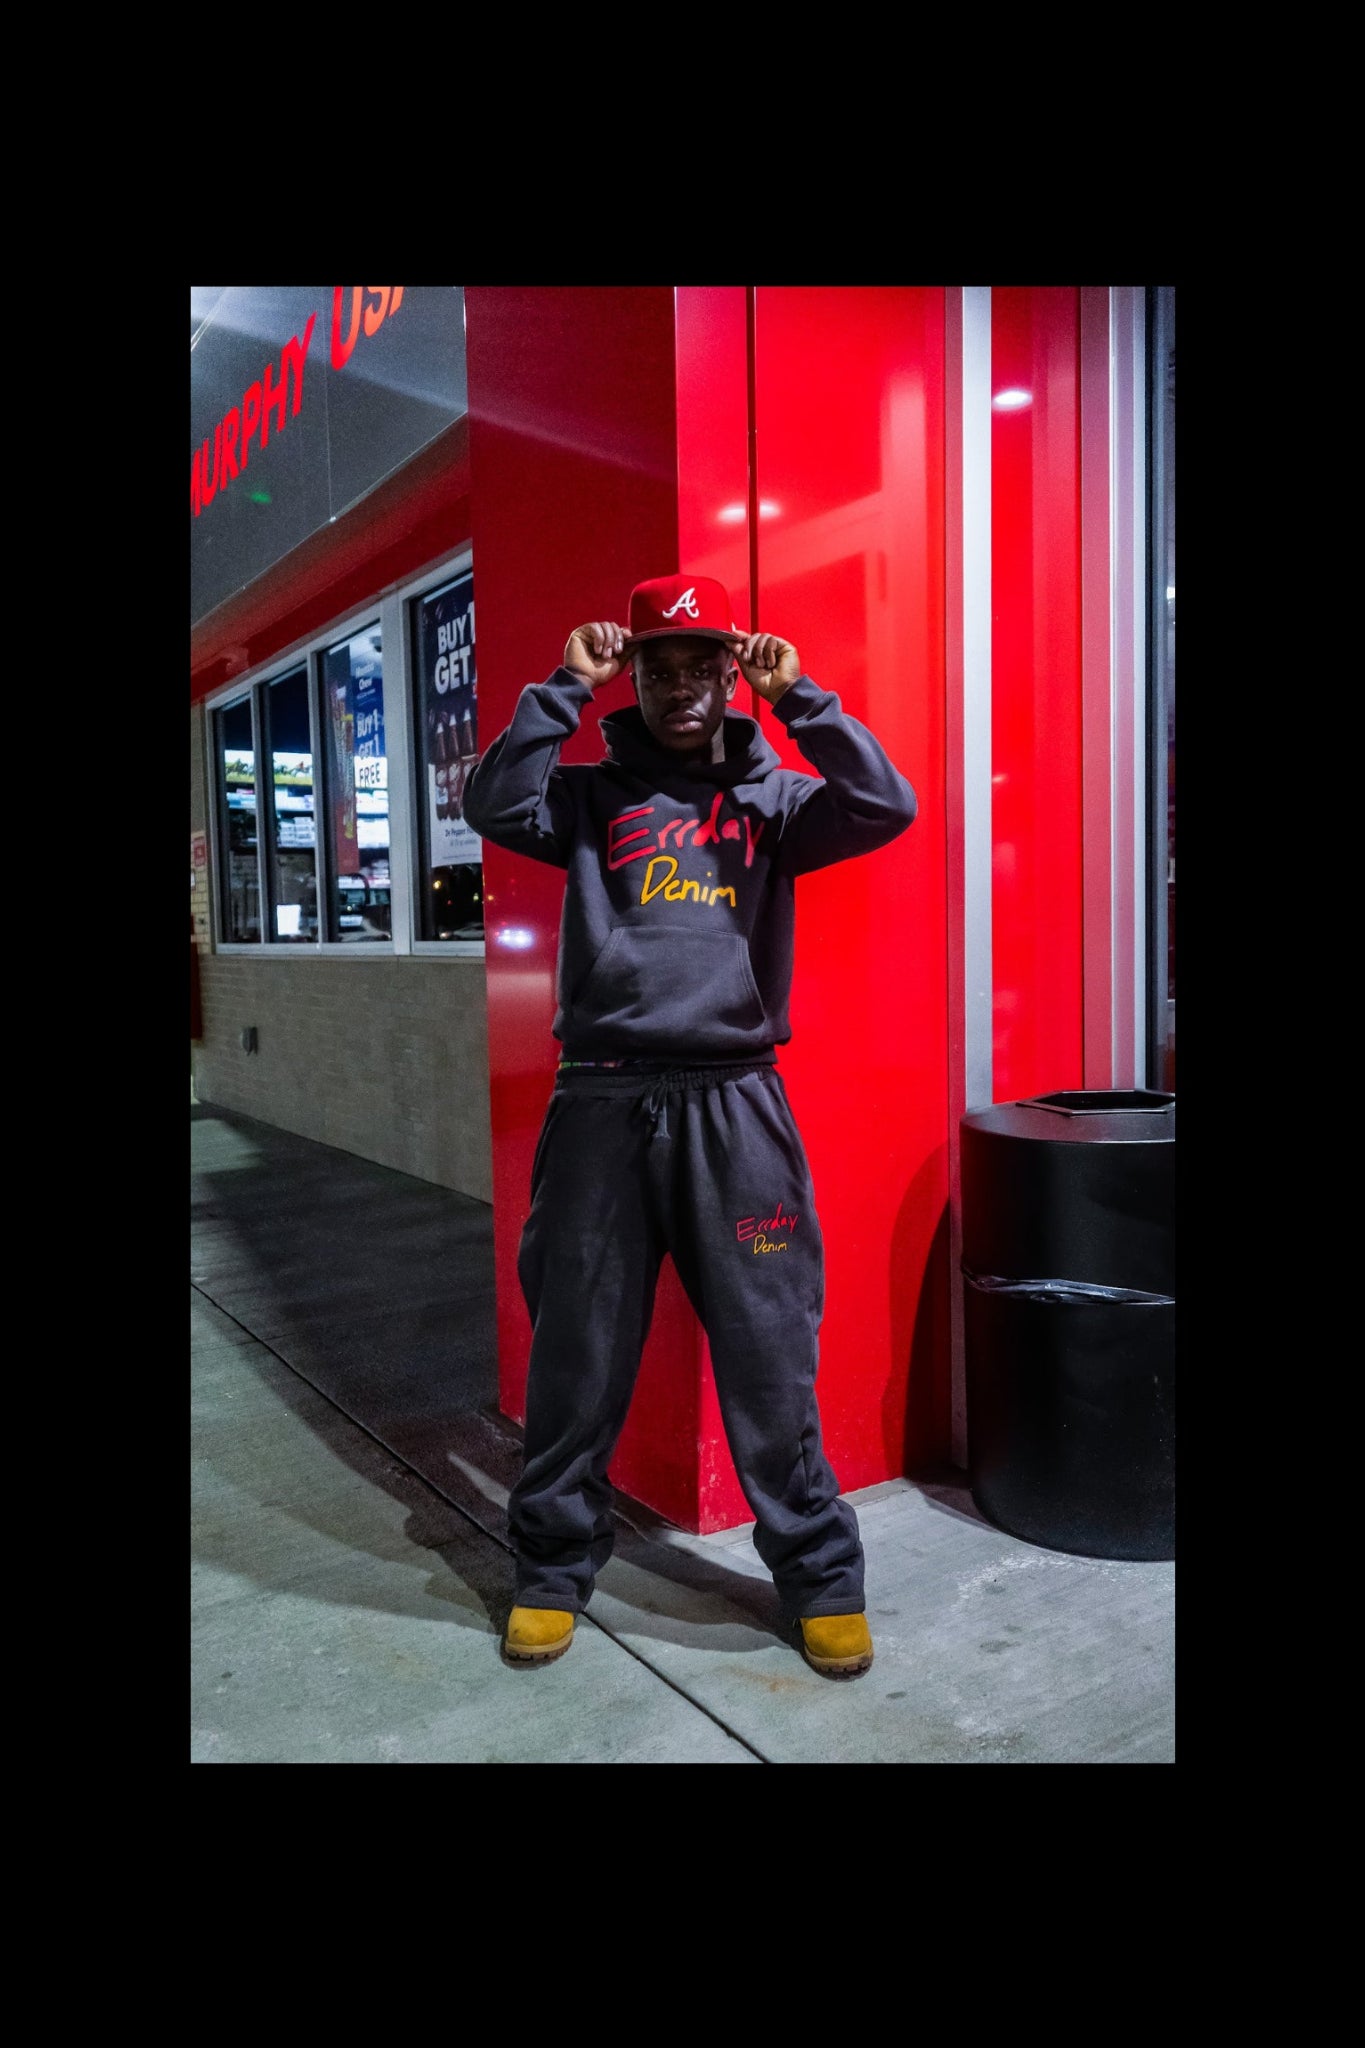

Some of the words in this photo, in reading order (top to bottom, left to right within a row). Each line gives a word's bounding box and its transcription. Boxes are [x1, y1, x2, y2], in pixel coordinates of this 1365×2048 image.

[330, 286, 404, 371] US
[662, 587, 700, 618] A
[437, 613, 468, 655] BUY
[435, 645, 471, 695] GET
[357, 714, 373, 738] BUY
[358, 740, 374, 760] GET
[359, 762, 381, 787] FREE
[607, 791, 765, 870] Errday
[640, 855, 737, 907] Denim
[736, 1202, 799, 1242] Errday
[753, 1234, 788, 1256] Denim
